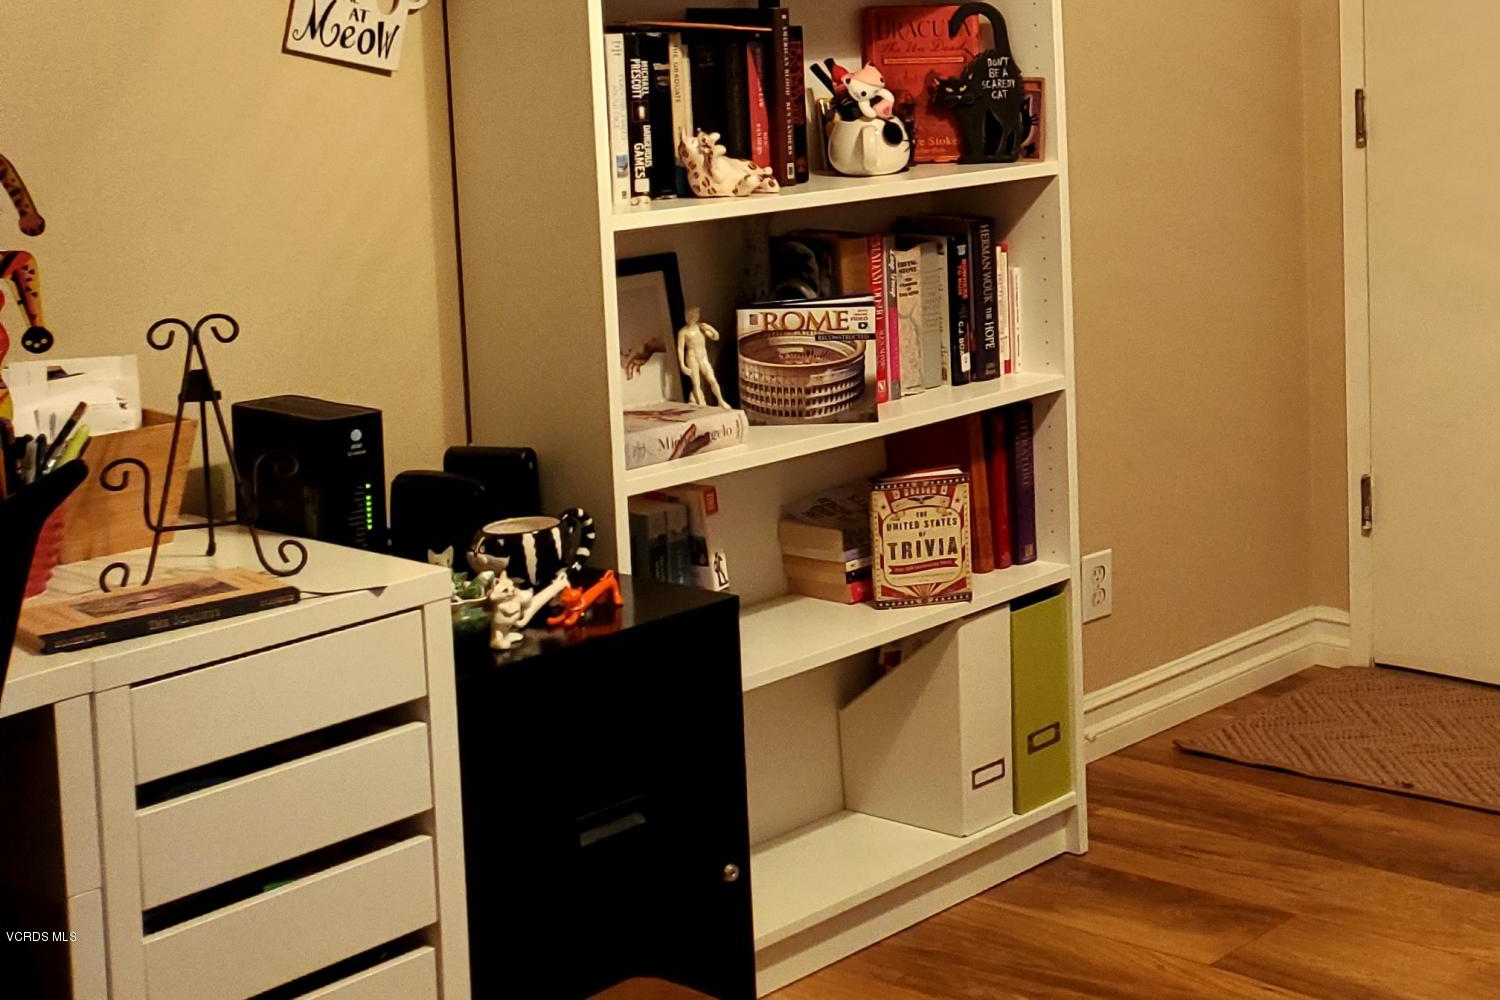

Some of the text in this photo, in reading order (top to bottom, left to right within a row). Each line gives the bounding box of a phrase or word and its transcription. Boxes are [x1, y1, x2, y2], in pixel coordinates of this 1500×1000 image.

[349, 8, 371, 23] AT
[877, 19, 972, 41] DRACUA
[781, 26, 791, 67] AMERICAN
[630, 58, 643, 100] PRESCOTT
[641, 59, 650, 95] MICHAEL
[673, 62, 682, 103] GRADUATE
[981, 78, 1016, 90] SCAREDY
[989, 68, 1009, 78] BE A
[991, 90, 1009, 100] CAT
[633, 142, 646, 179] GAMES
[979, 223, 990, 271] HERMAN
[982, 271, 993, 304] WOUK
[759, 310, 850, 332] ROME
[984, 321, 996, 351] HOPE
[886, 517, 958, 532] UNITED STATES
[886, 536, 958, 561] TRIVIA
